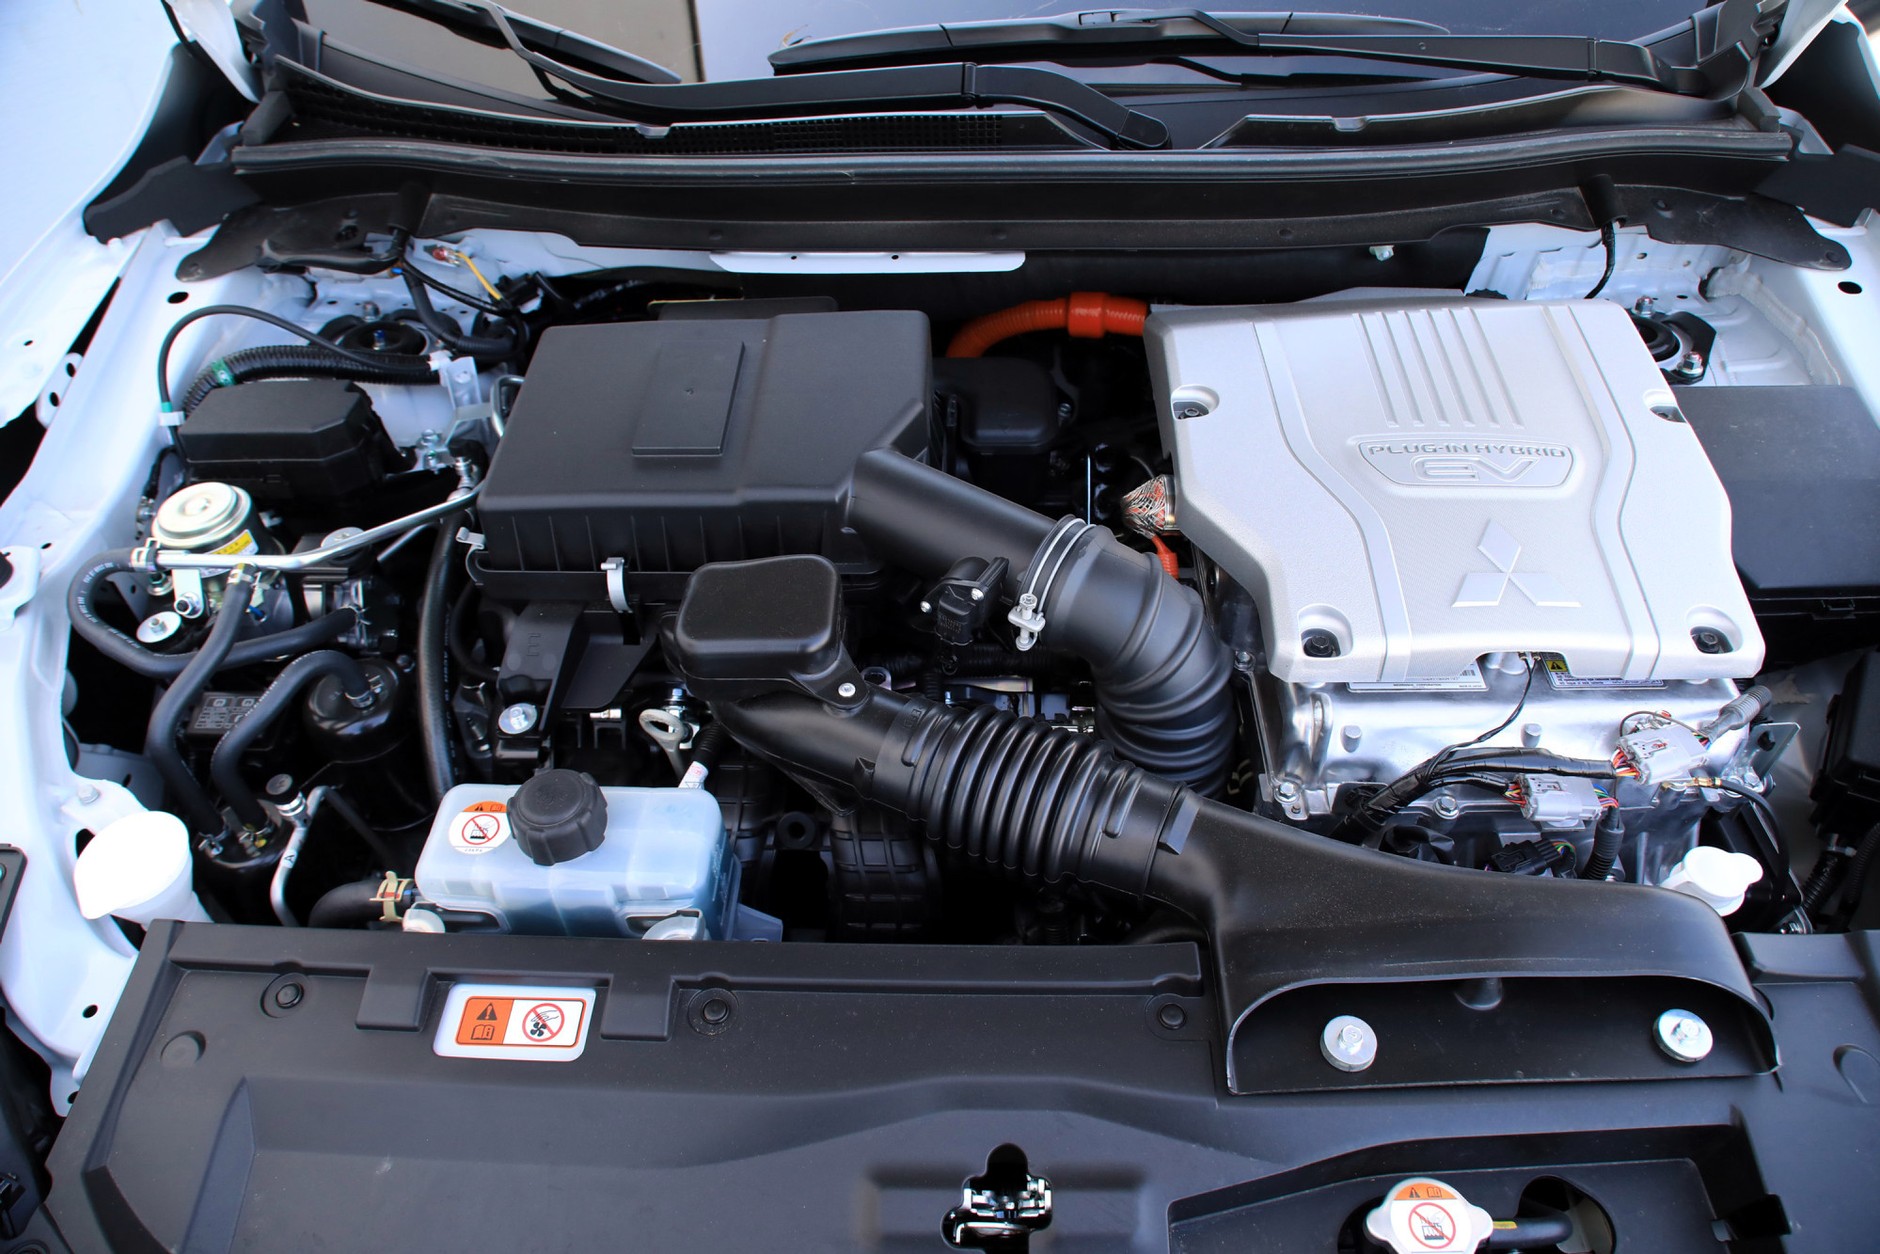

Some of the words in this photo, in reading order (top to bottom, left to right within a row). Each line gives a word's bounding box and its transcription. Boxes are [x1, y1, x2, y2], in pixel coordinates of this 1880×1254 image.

[1367, 442, 1469, 455] PLUG-IN
[1473, 443, 1566, 457] HYBRID
[1411, 455, 1540, 482] EV
